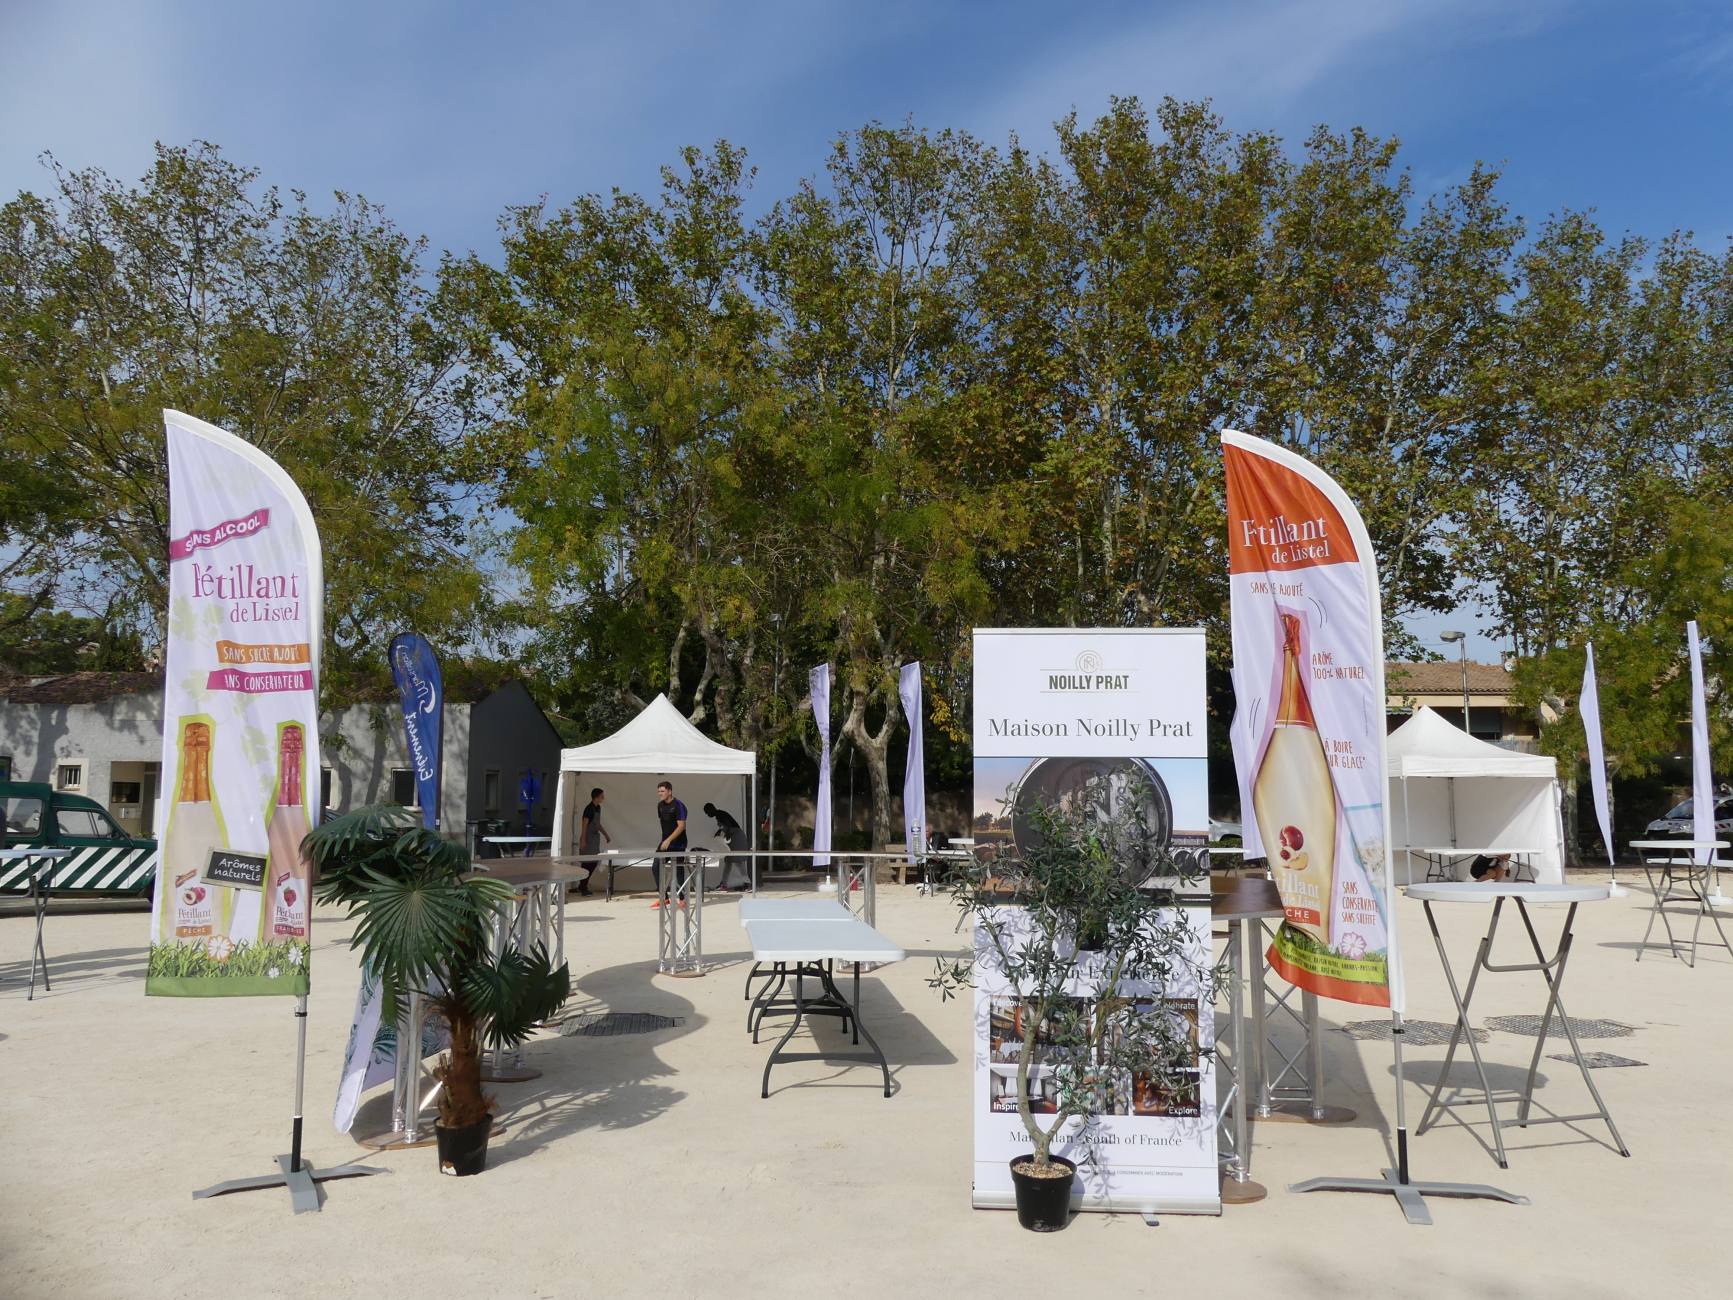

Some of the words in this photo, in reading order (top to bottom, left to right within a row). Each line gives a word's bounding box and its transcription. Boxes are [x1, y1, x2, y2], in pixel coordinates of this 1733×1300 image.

[214, 515, 260, 543] ALCOOL
[1272, 547, 1288, 563] de
[1289, 540, 1330, 562] Listel
[1250, 582, 1269, 594] SANS
[230, 602, 248, 623] de
[223, 646, 246, 662] SANS
[249, 647, 271, 662] SUCRE
[1335, 666, 1364, 680] NATUREL
[244, 674, 305, 691] CONSERVATEUR
[1049, 674, 1091, 690] NOILLY
[1095, 674, 1129, 690] PRAT
[988, 718, 1068, 737] Maison
[1076, 718, 1141, 742] Noilly
[1149, 718, 1193, 737] Prat
[1333, 739, 1353, 754] BOIRE
[218, 858, 261, 872] Arômes
[214, 868, 261, 882] naturels
[1342, 881, 1358, 895] SANS
[1341, 912, 1355, 923] SANS
[1168, 1106, 1198, 1116] Explore
[1124, 1134, 1137, 1146] of
[1138, 1135, 1183, 1148] France
